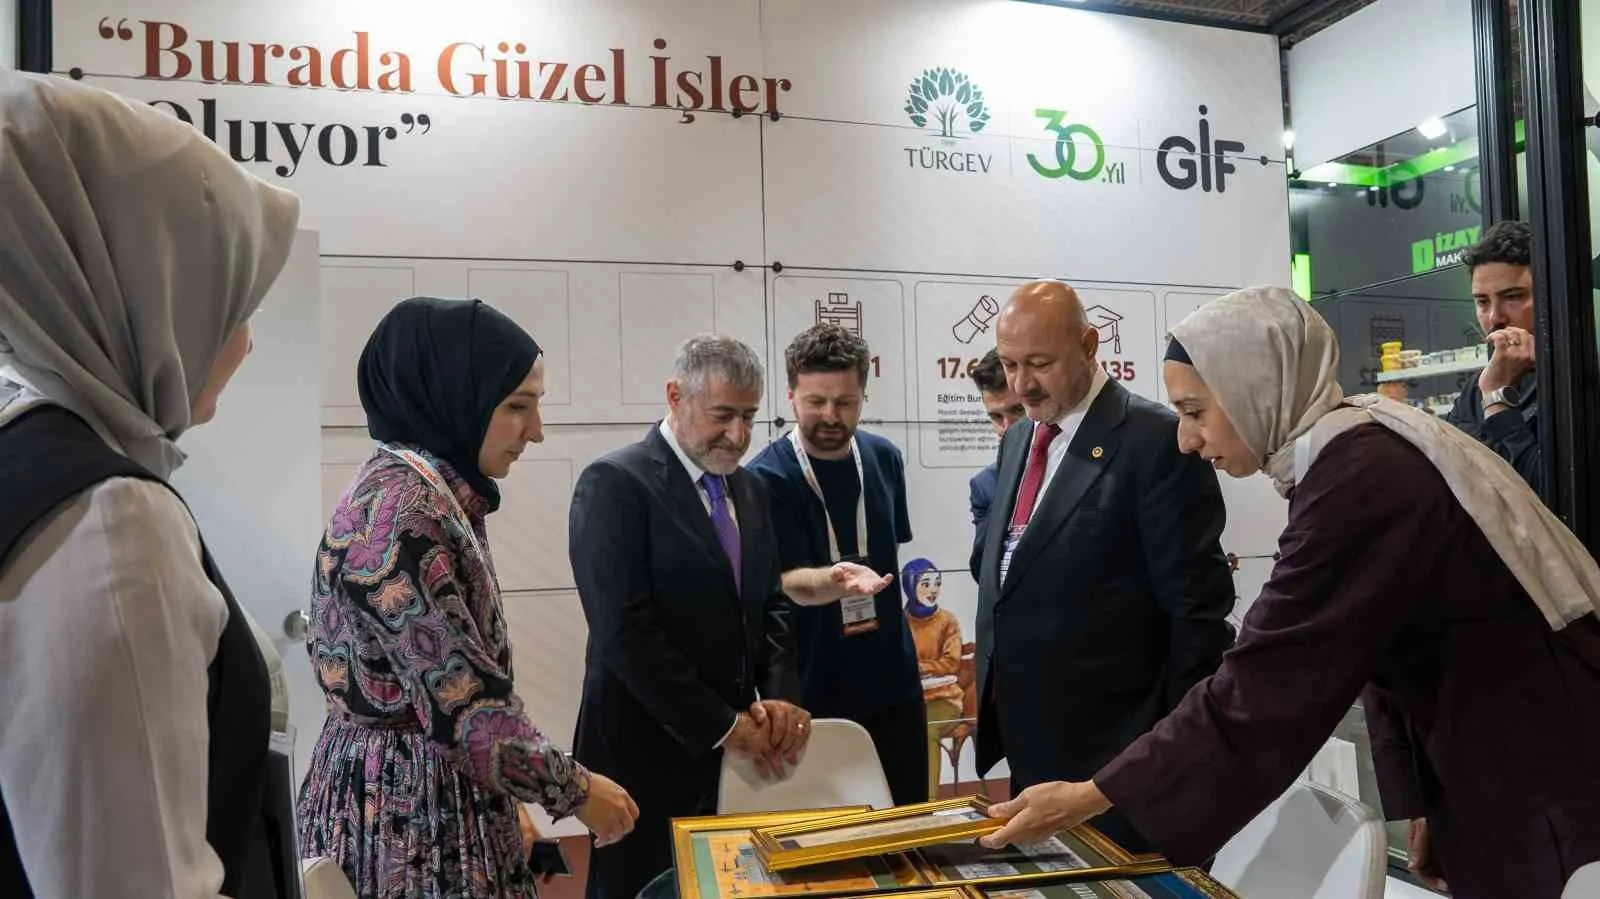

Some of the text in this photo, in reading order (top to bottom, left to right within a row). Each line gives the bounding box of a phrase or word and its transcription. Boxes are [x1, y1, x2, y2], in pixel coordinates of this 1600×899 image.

[437, 41, 630, 106] Güzel
[647, 38, 791, 124] İşler
[904, 147, 993, 174] TÜRGEV
[1156, 104, 1245, 193] GİF
[1412, 225, 1481, 274] DİZAY
[1435, 249, 1466, 268] MAK
[937, 393, 983, 404] Eğitim Bur
